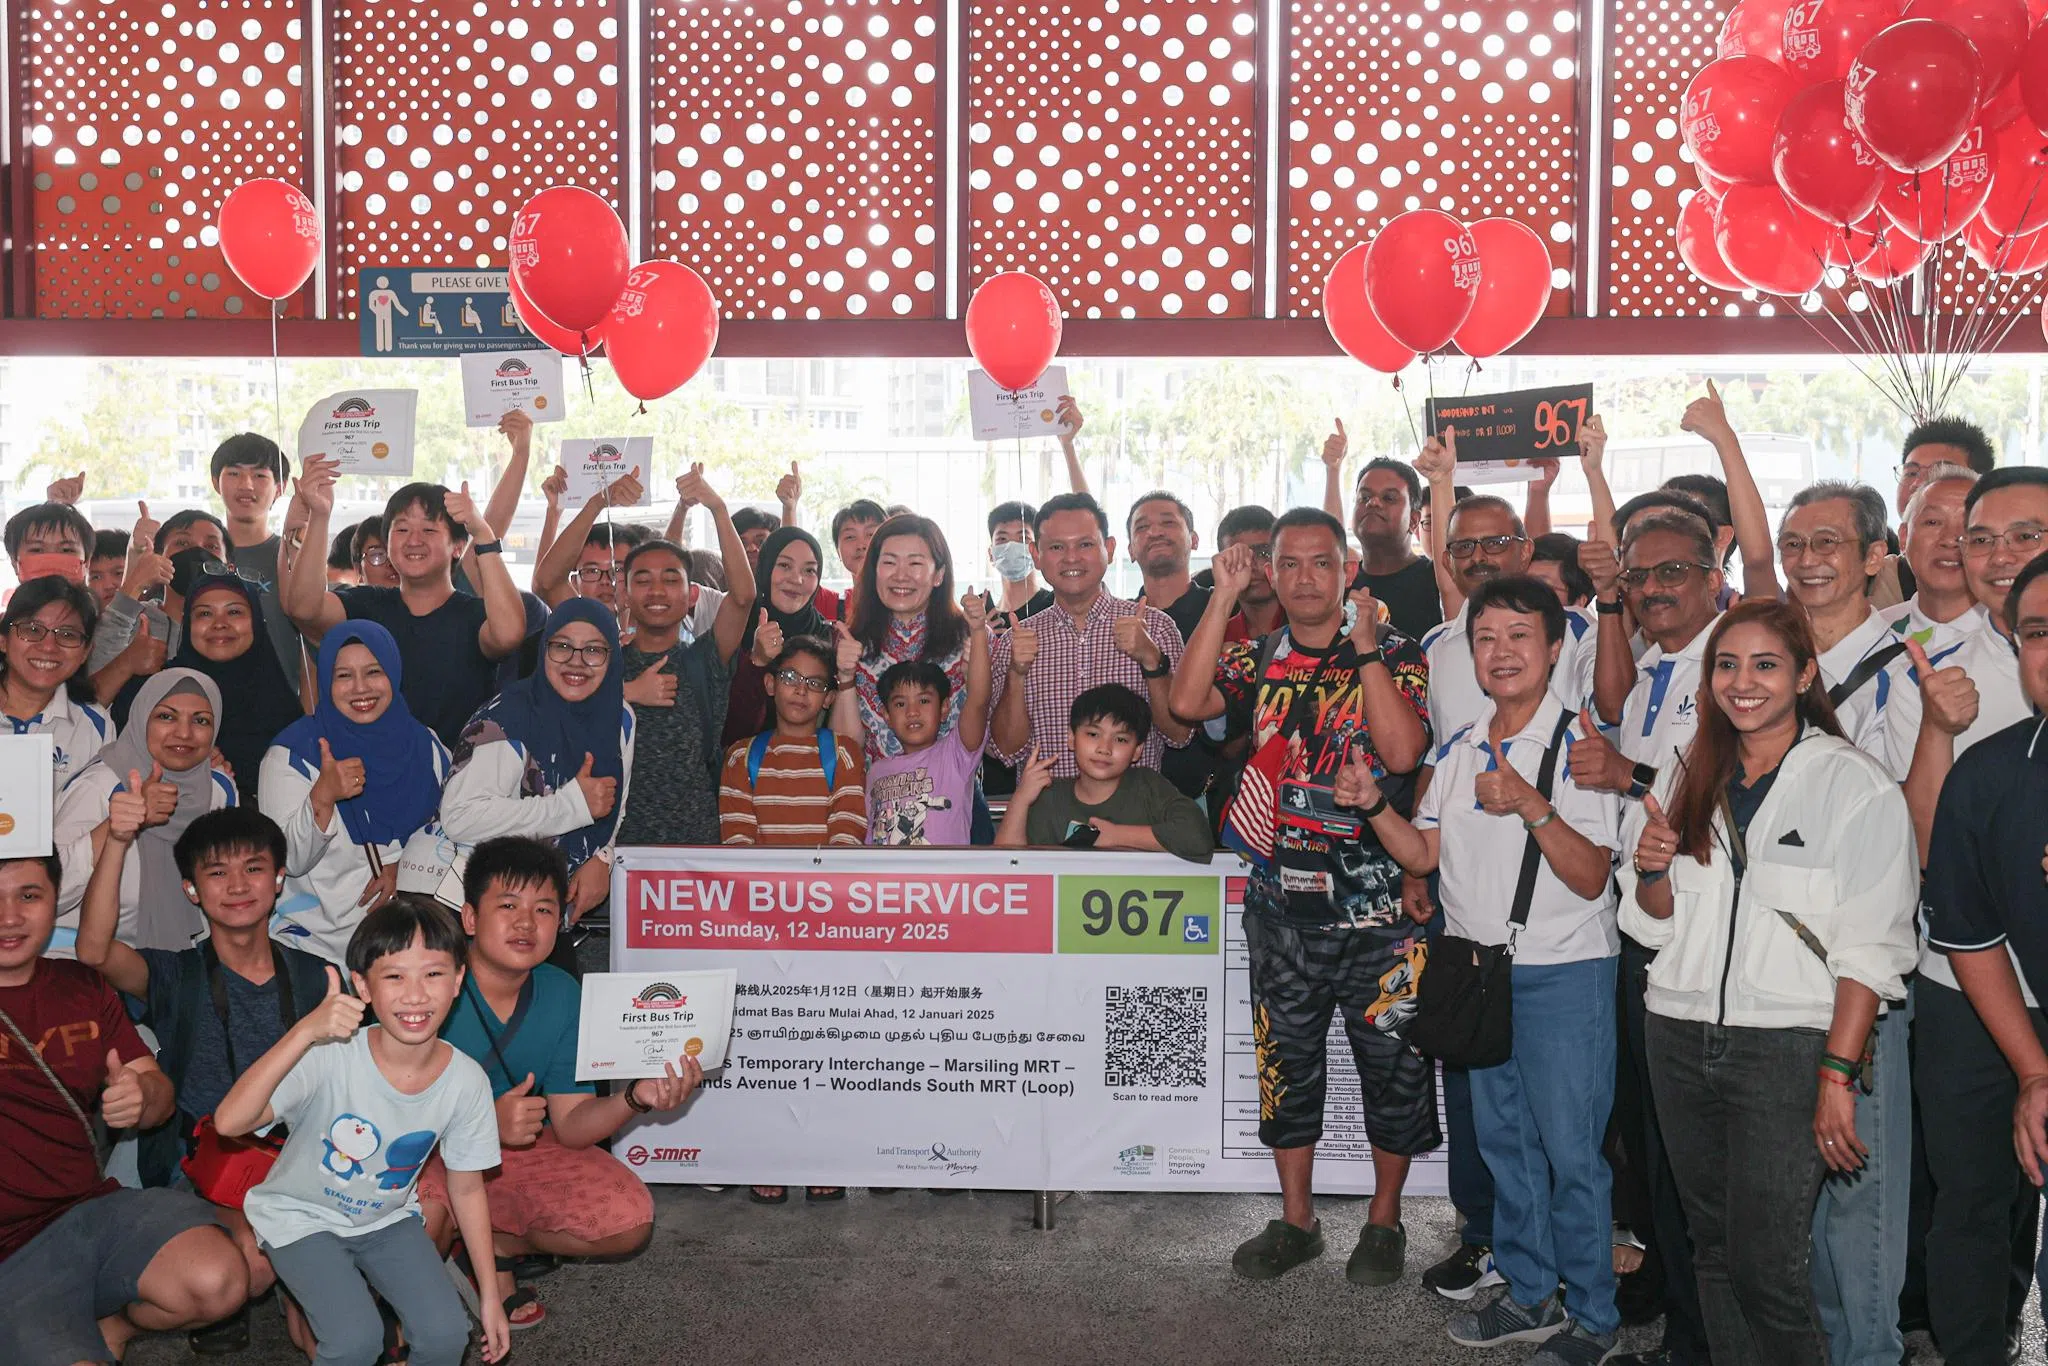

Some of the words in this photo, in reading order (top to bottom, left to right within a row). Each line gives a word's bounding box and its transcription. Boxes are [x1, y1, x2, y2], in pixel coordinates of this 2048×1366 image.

[432, 277, 472, 288] PLEASE
[475, 277, 500, 288] GIVE
[627, 271, 660, 288] 67
[398, 341, 419, 349] Thank
[432, 341, 442, 349] for
[444, 342, 463, 351] giving
[464, 343, 477, 351] way
[486, 342, 521, 351] passengers
[491, 379, 508, 387] First
[509, 378, 523, 386] Bus
[524, 378, 538, 386] Trip
[996, 392, 1013, 401] First
[1014, 392, 1028, 400] us
[1030, 391, 1044, 399] Trip
[324, 421, 342, 430] First
[345, 420, 360, 428] Bus
[363, 419, 380, 429] Trip
[1534, 397, 1588, 449] 967
[402, 860, 444, 876] Woodg
[640, 879, 735, 912] NEW
[749, 880, 834, 913] BUS
[847, 881, 1029, 915] SERVICE
[1082, 889, 1184, 936] 967
[641, 919, 692, 937] From
[700, 920, 779, 941] Sunday,
[787, 921, 809, 938] 12
[815, 922, 895, 943] January
[902, 923, 949, 940] 2025
[622, 1012, 646, 1023] First
[650, 1012, 670, 1022] Bus
[673, 1011, 694, 1022] Trip
[733, 1008, 768, 1017] idmat
[772, 1008, 794, 1017] Bas
[797, 1008, 825, 1018] Baru
[829, 1008, 861, 1018] Mulai
[863, 1008, 898, 1020] Ahad,
[902, 1009, 916, 1019] 12
[919, 1009, 963, 1020] Januari
[967, 1010, 995, 1020] 2025
[730, 1028, 743, 1038] 25
[737, 1056, 824, 1072] Temporary
[829, 1057, 925, 1074] Interchange
[944, 1058, 1019, 1075] Marsiling
[1024, 1060, 1061, 1073] MRT
[737, 1077, 797, 1090] Avenue
[802, 1078, 810, 1090] 1
[831, 1078, 922, 1091] Woodlands
[927, 1079, 974, 1093] South
[980, 1080, 1016, 1093] MRT
[1021, 1080, 1074, 1096] (Loop)
[1113, 1092, 1136, 1101] Scan
[1139, 1093, 1148, 1101] to
[651, 1148, 701, 1160] SMRT
[877, 1146, 894, 1155] Land
[895, 1146, 930, 1157] Transport
[946, 1147, 981, 1158] Authority
[1169, 1147, 1210, 1155] Connecting
[1169, 1161, 1205, 1169] Improving
[1169, 1168, 1201, 1176] Journeys
[324, 1187, 353, 1203] STAND
[356, 1199, 369, 1207] BY
[371, 1200, 384, 1209] ME
